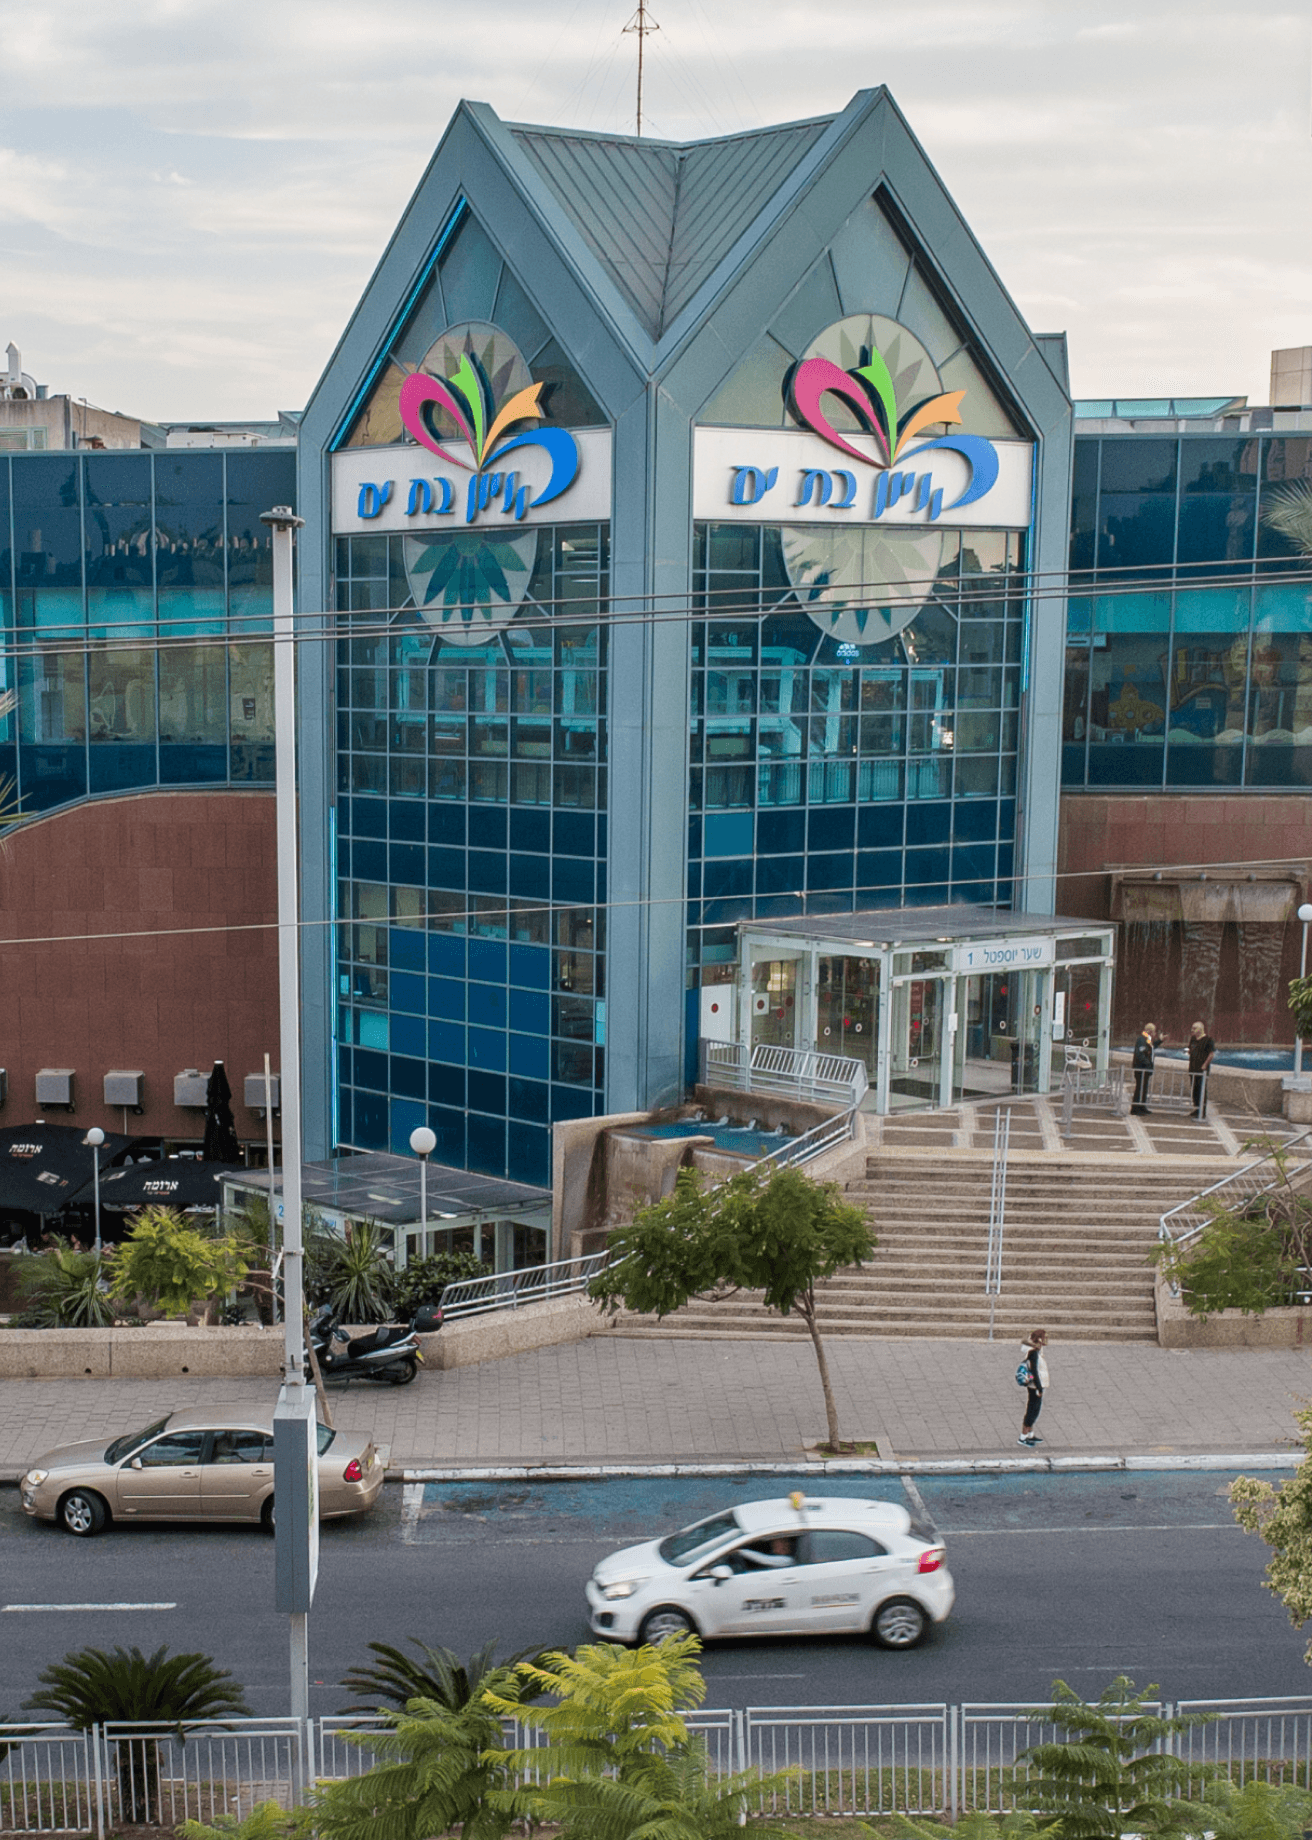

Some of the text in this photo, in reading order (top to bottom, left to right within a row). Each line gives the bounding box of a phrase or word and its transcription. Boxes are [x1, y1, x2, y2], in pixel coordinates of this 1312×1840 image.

[357, 426, 579, 524] קניון בת ים
[731, 434, 1000, 522] קניון בת ים
[967, 947, 1042, 966] שער יוספטל 1
[8, 1143, 43, 1154] ארומה
[142, 1180, 179, 1191] ארומה
